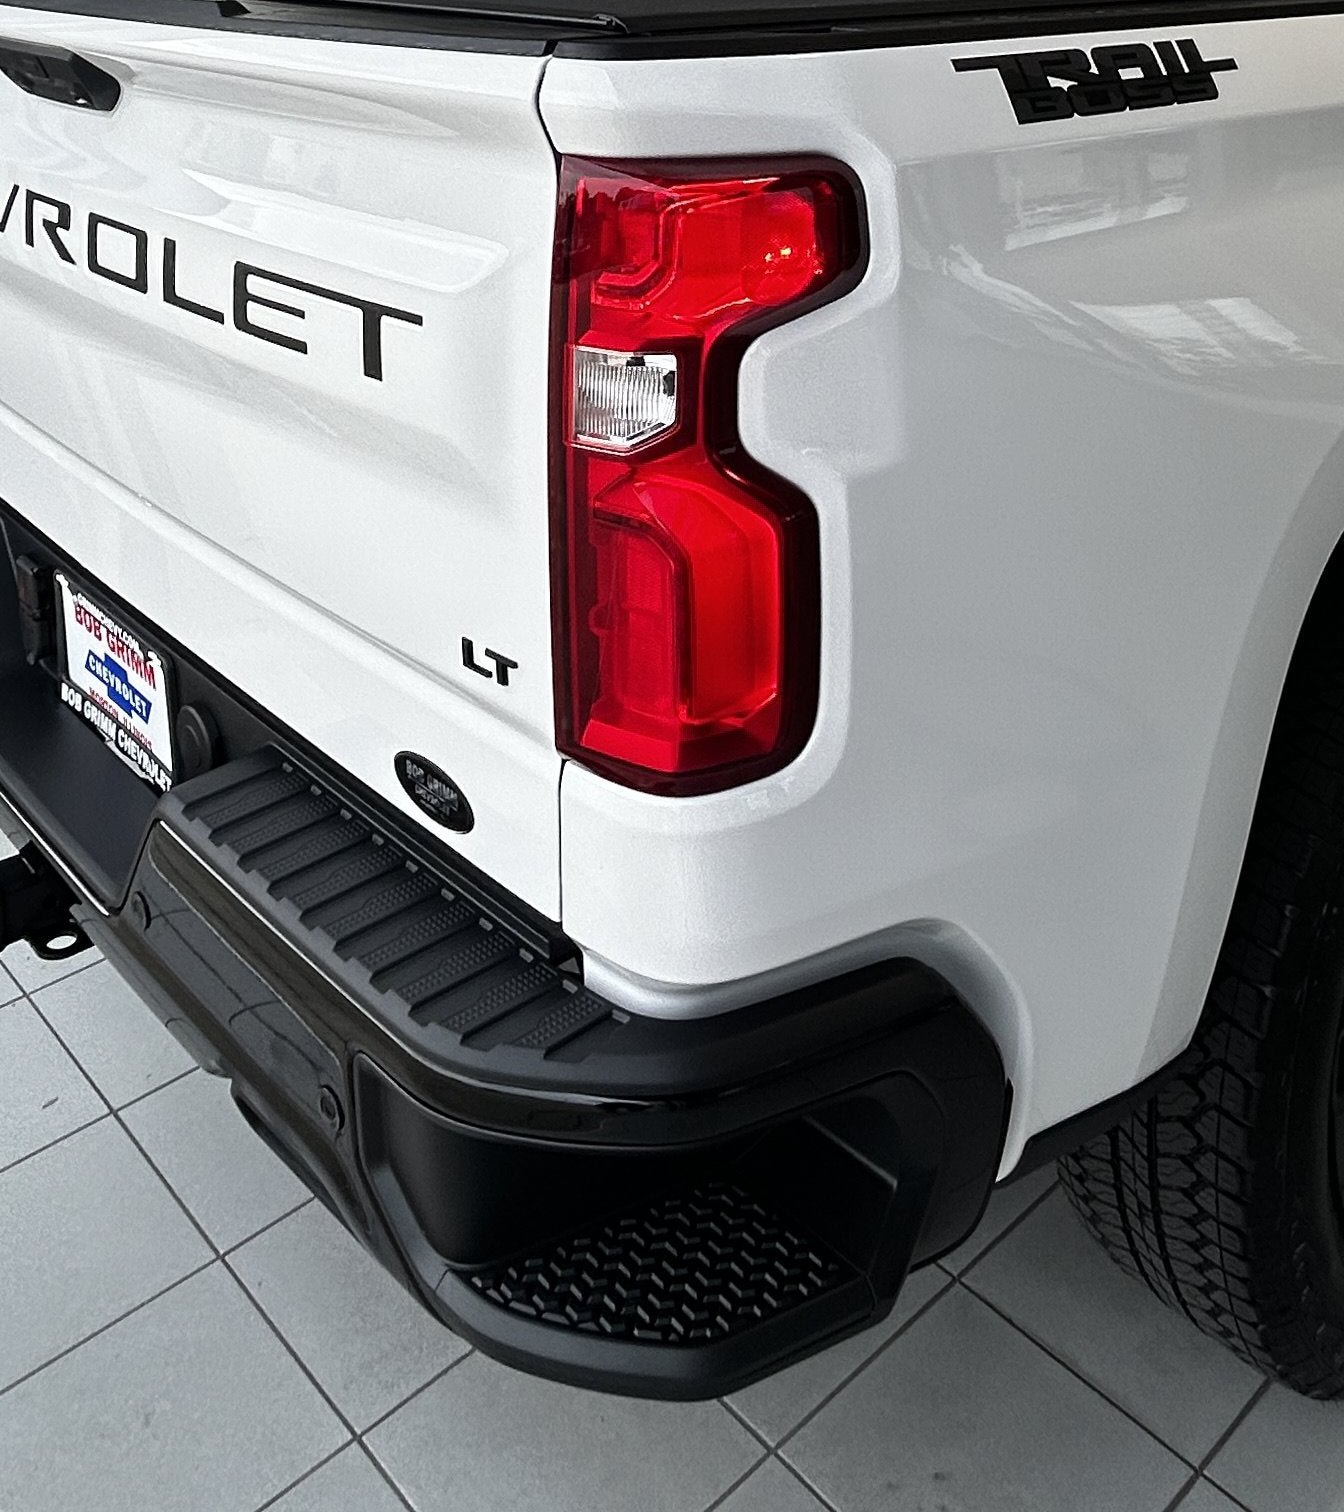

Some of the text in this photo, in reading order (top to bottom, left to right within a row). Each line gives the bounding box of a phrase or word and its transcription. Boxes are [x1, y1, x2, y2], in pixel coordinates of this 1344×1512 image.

[950, 38, 1238, 94] TRAIL
[75, 605, 157, 690] BOB GRIMM
[462, 637, 518, 686] LT
[88, 654, 148, 718] CHEVROLET
[61, 683, 172, 792] BOB GRIMM CHEVROLET
